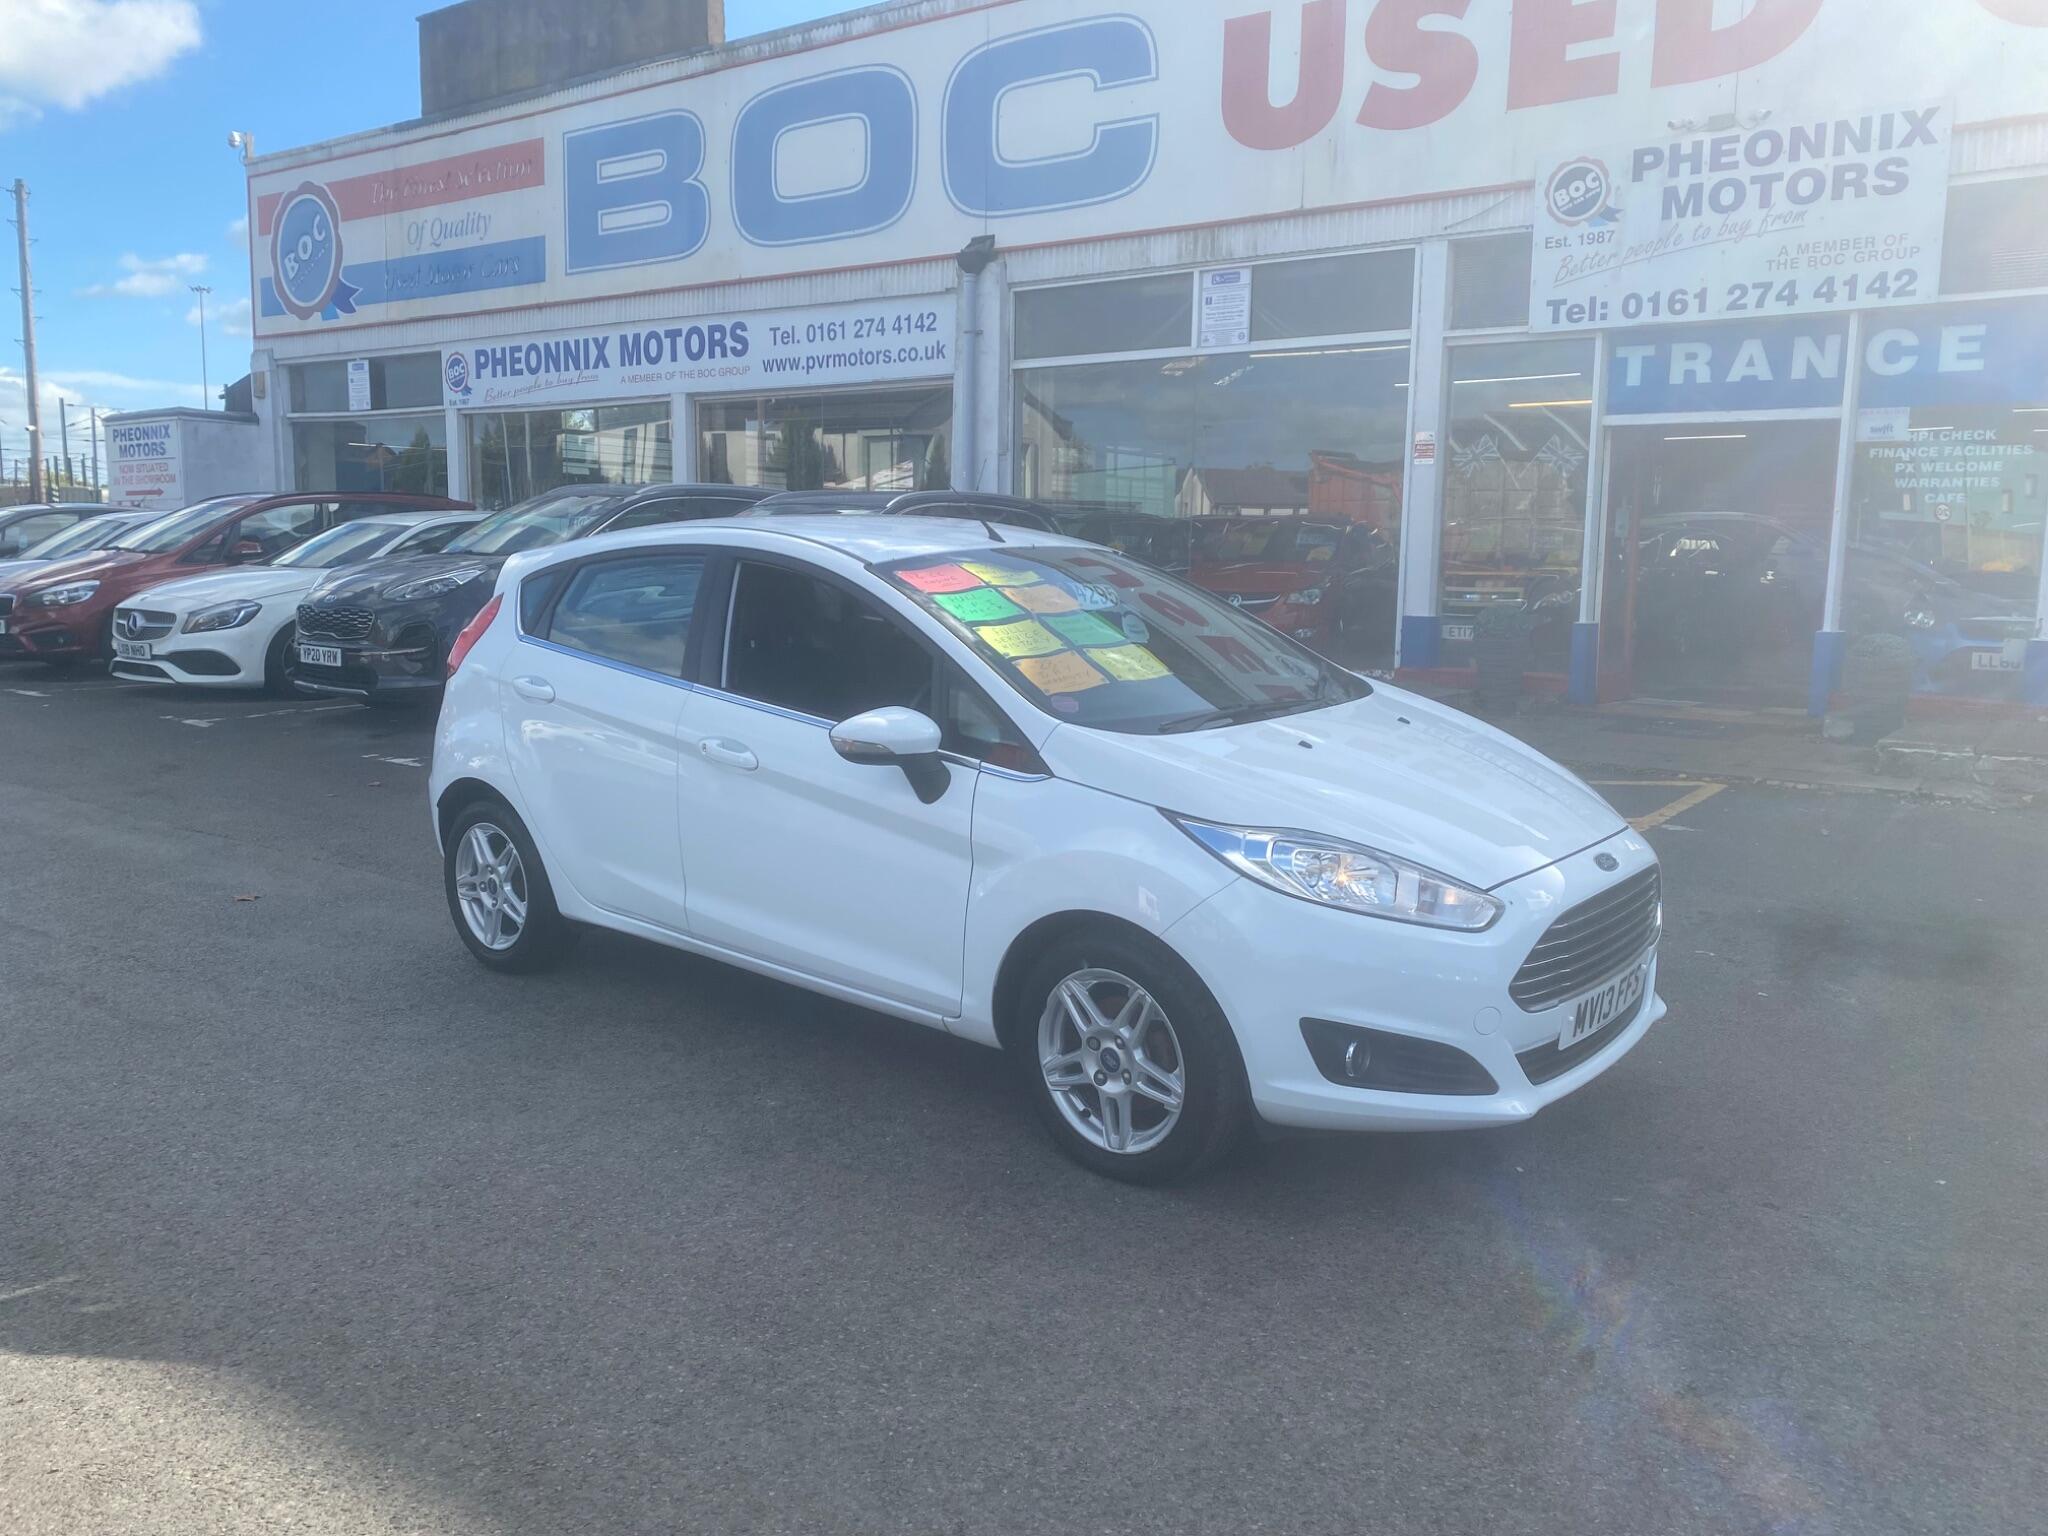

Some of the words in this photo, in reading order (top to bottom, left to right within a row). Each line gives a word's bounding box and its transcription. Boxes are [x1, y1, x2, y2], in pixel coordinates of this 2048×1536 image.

[563, 13, 1160, 275] BOC
[1221, 0, 1823, 150] USED
[1632, 106, 1941, 182] PHEONNIX
[1554, 171, 1600, 207] BOC
[1661, 157, 1910, 220] MOTORS
[284, 212, 326, 281] BOC
[407, 219, 427, 250] Of
[430, 212, 492, 247] Quality
[1544, 236, 1572, 249] Est.
[1578, 230, 1615, 246] 1987
[1554, 249, 1618, 282] Better
[1621, 225, 1684, 266] people
[1692, 222, 1711, 242] to
[1717, 212, 1751, 244] buy
[1756, 203, 1808, 238] from
[1777, 245, 1790, 258] A
[1796, 237, 1876, 256] MEMBER
[1883, 233, 1909, 247] OF
[1765, 257, 1800, 272] THE
[1807, 252, 1846, 269] BOC
[1852, 245, 1921, 264] GROUP
[1545, 296, 1609, 325] Tel:
[1621, 287, 1708, 319] 0161
[1726, 279, 1798, 311] 274
[1813, 268, 1918, 303] 4142
[769, 326, 800, 347] Tel.
[806, 321, 846, 344] 0161
[853, 317, 887, 340] 274
[891, 312, 937, 337] 4142
[474, 335, 609, 379] PHEONNIX
[619, 321, 749, 367] MOTORS
[762, 340, 946, 375] www.pvrmotors.co.uk
[1615, 323, 1988, 386] TRANCE
[448, 363, 465, 379] BOC
[620, 375, 627, 384] A
[628, 372, 663, 384] MEMBER
[664, 371, 676, 382] OF
[679, 369, 696, 380] THE
[697, 367, 716, 379] BOC
[718, 365, 750, 377] GROUP
[113, 425, 170, 442] PHEONNIX
[1907, 431, 1934, 442] HPI
[1939, 429, 1997, 441] CHECK
[119, 442, 166, 457] MOTORS
[1869, 447, 1939, 459] FINANCE
[1943, 444, 2034, 457] FACILITIES
[1895, 463, 1915, 473] PX
[1921, 461, 2003, 473] WELCOME
[1895, 476, 2001, 489] WARRANTIES
[1924, 493, 1967, 504] CAFE
[303, 648, 320, 661] YP20
[1573, 985, 1615, 1037] MV13
